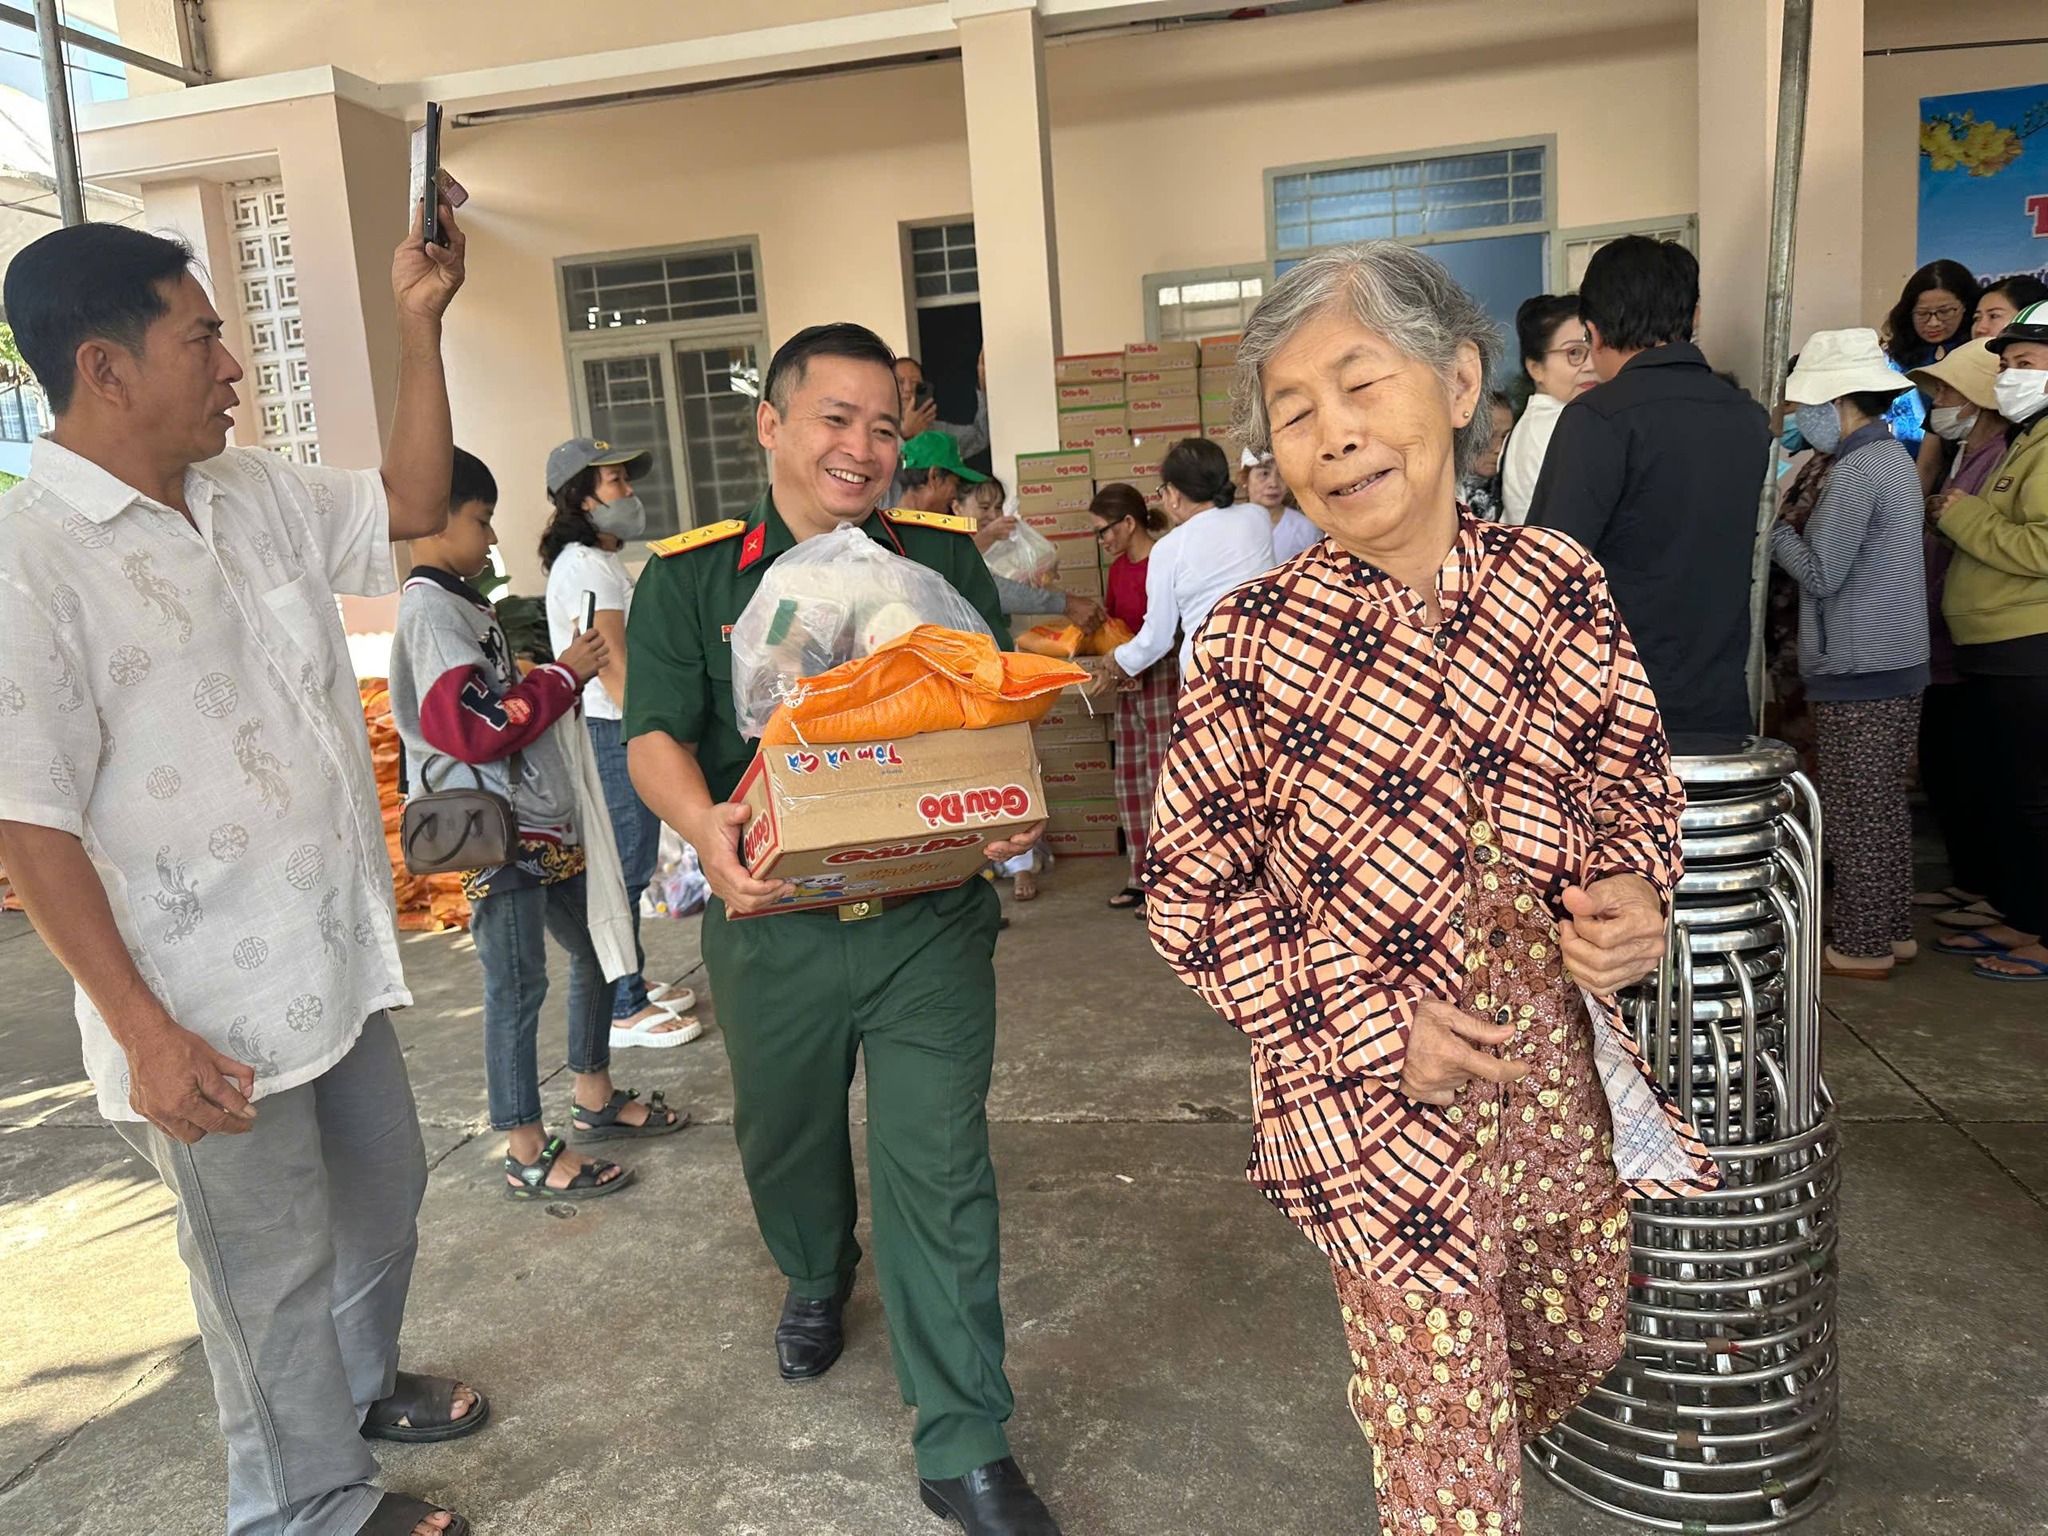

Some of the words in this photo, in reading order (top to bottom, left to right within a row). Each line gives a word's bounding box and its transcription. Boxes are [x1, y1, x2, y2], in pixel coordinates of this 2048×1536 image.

[785, 752, 820, 774] Gà
[824, 749, 851, 770] và
[856, 744, 903, 765] Tôm
